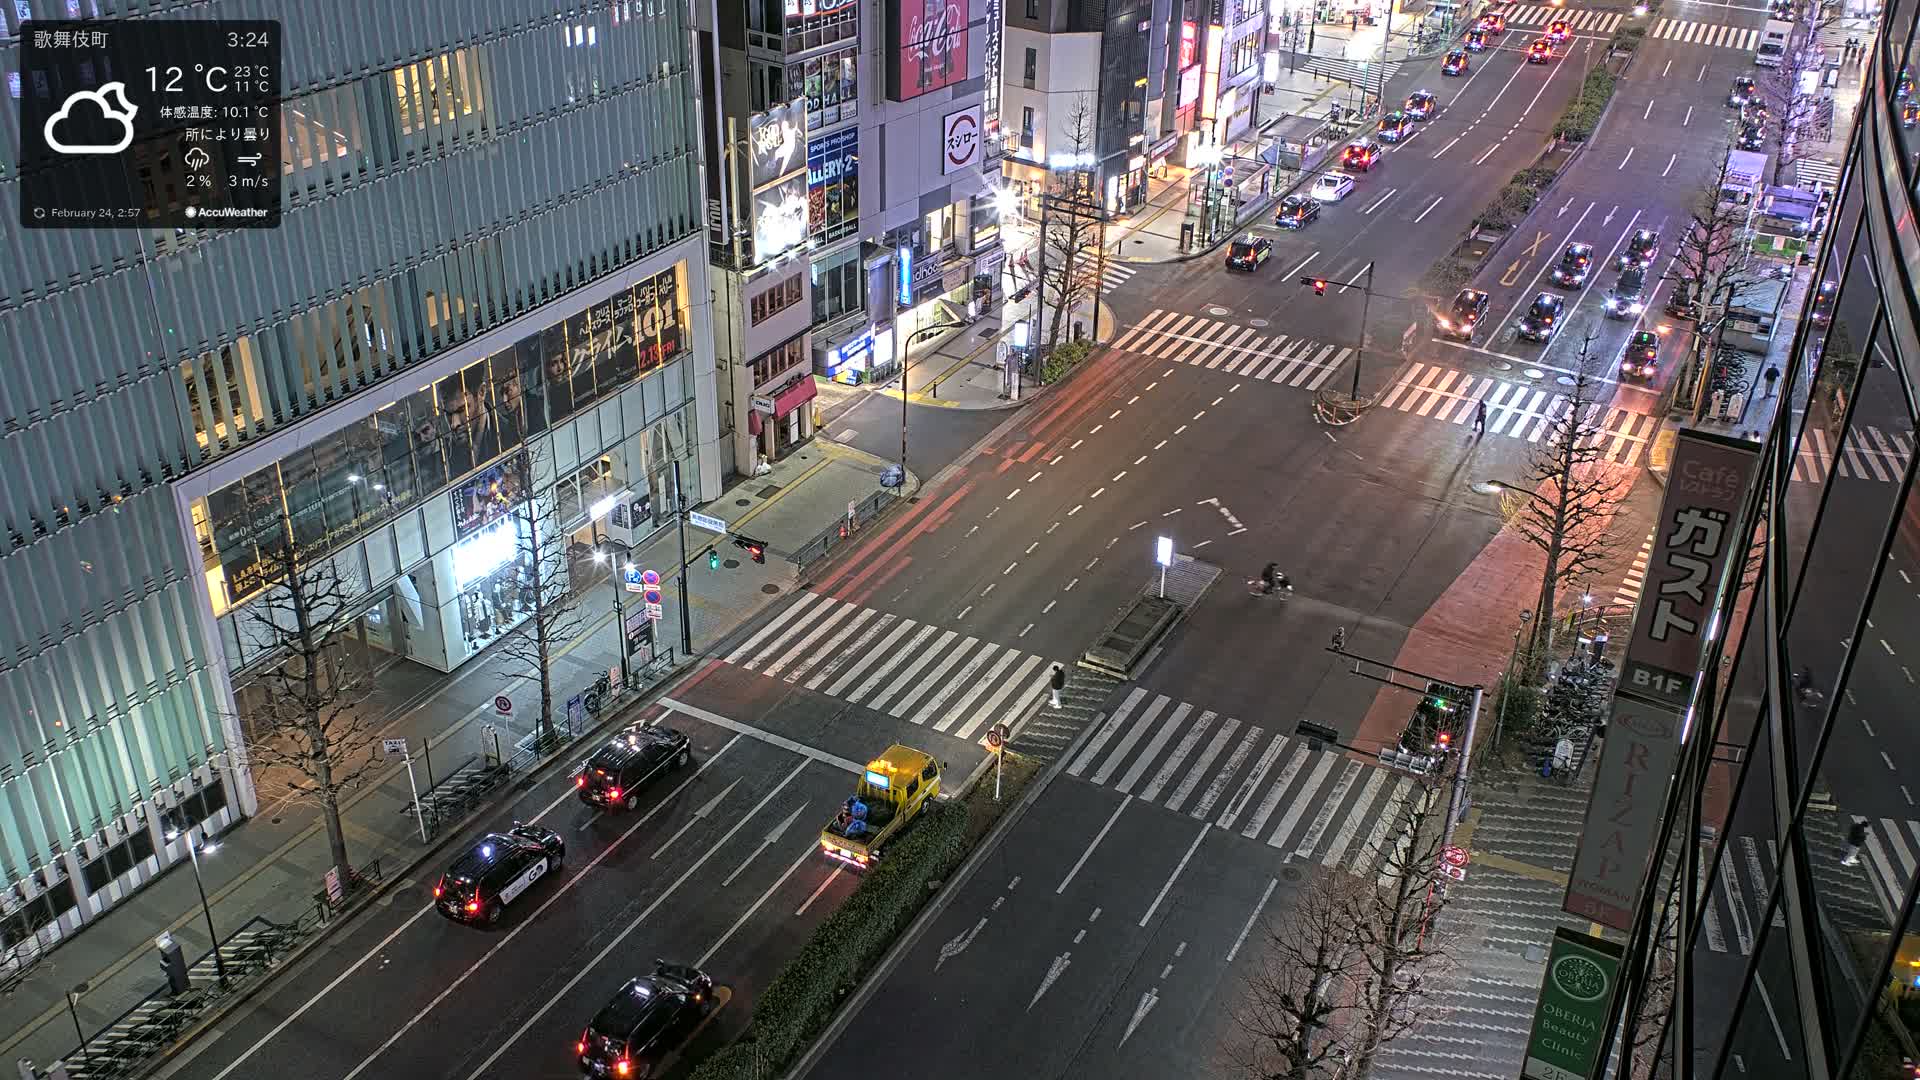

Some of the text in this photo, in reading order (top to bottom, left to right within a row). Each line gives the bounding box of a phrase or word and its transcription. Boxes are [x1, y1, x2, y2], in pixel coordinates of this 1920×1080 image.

[810, 140, 830, 153] SPORTS
[947, 131, 978, 151] スシロー
[709, 199, 722, 231] MUJI
[632, 299, 676, 346] 101
[661, 339, 676, 359] FRI
[755, 400, 771, 409] DUG
[1682, 459, 1738, 490] Café
[1650, 507, 1726, 641] ガスト
[1631, 668, 1684, 696] B1F
[1600, 742, 1649, 879] RIZAP
[1542, 1002, 1596, 1031] OBERIA
[1542, 1019, 1590, 1046] Beauty
[1541, 1037, 1584, 1061] Clinic
